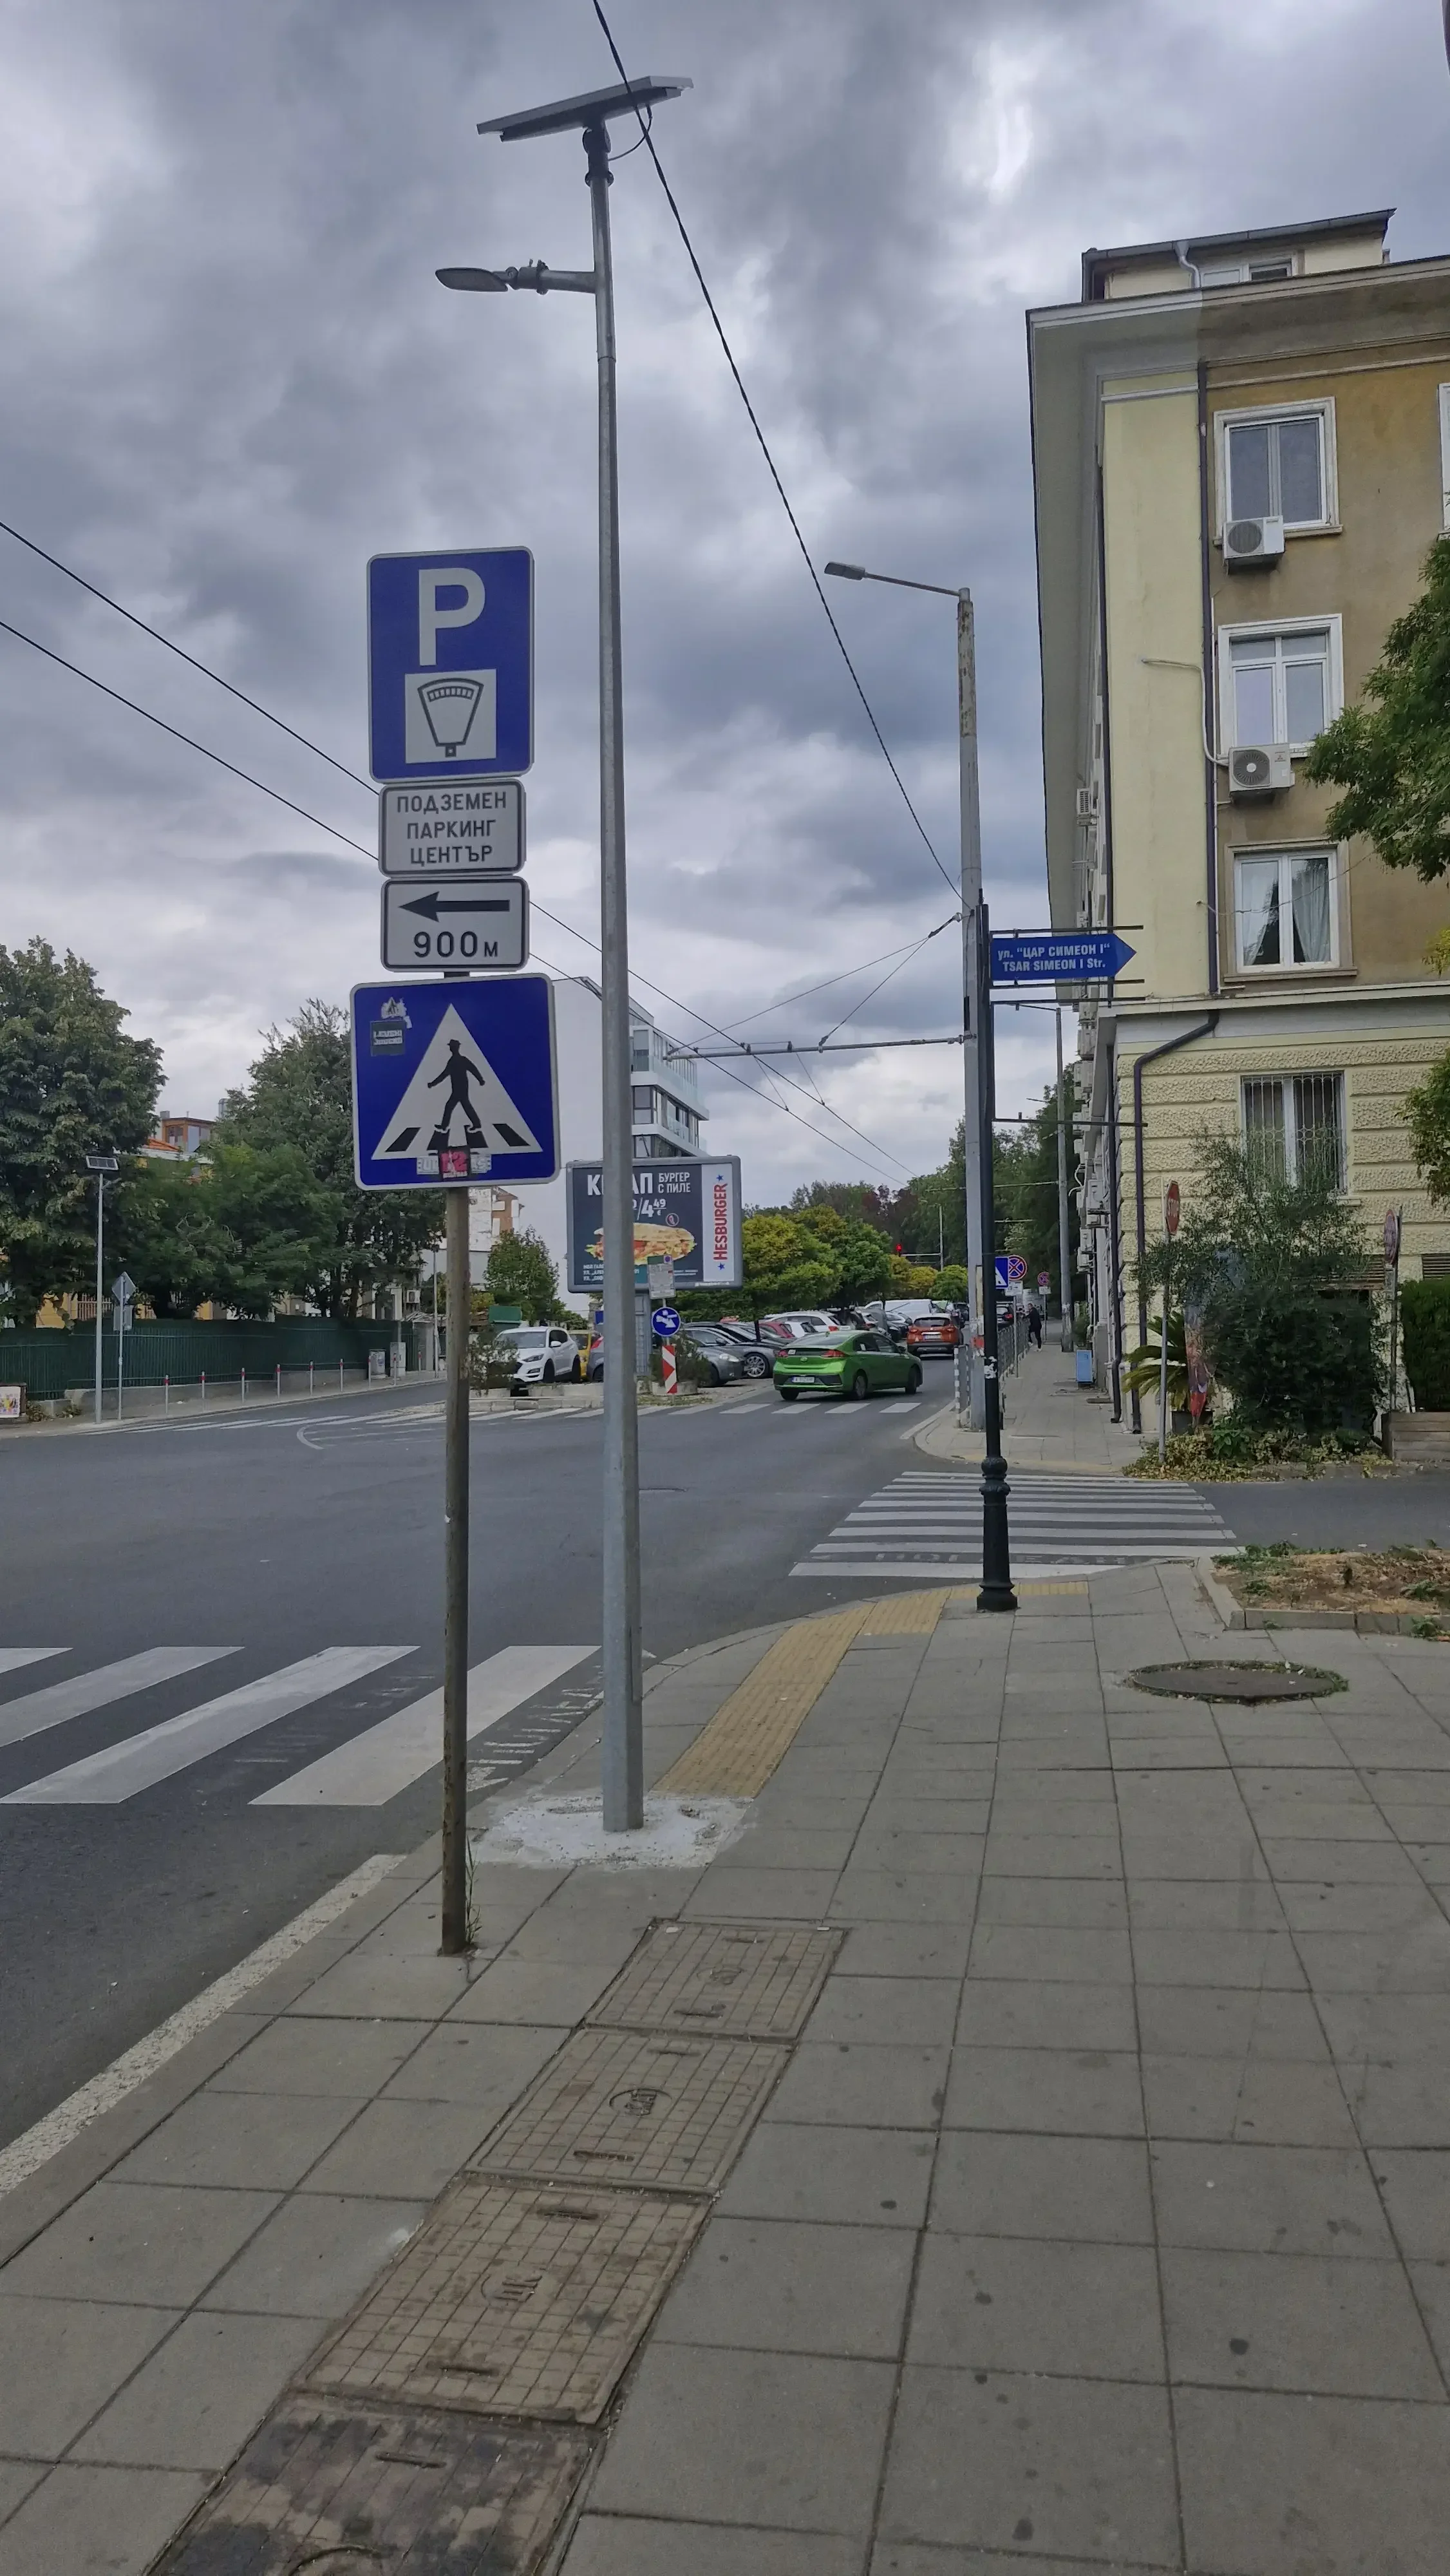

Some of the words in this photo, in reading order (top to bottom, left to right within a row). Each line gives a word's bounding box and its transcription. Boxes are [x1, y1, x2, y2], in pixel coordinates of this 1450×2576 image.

[419, 567, 486, 666] P
[397, 791, 507, 815] ПОДЗЕМЕН
[407, 819, 496, 840] ПАРКИНГ
[410, 845, 493, 866] ЦЕНТЪР
[997, 950, 1014, 961] ул.
[1048, 943, 1097, 957] СИМЕОН
[1003, 961, 1030, 972] TSAR
[1033, 958, 1077, 971] SIMEON
[1080, 958, 1084, 967] I
[1086, 958, 1106, 969] Str.
[658, 1172, 690, 1183] БУРГЕР
[658, 1183, 664, 1193] С
[666, 1182, 691, 1193] ПИЛЕ
[713, 1182, 728, 1260] HESBURGER
